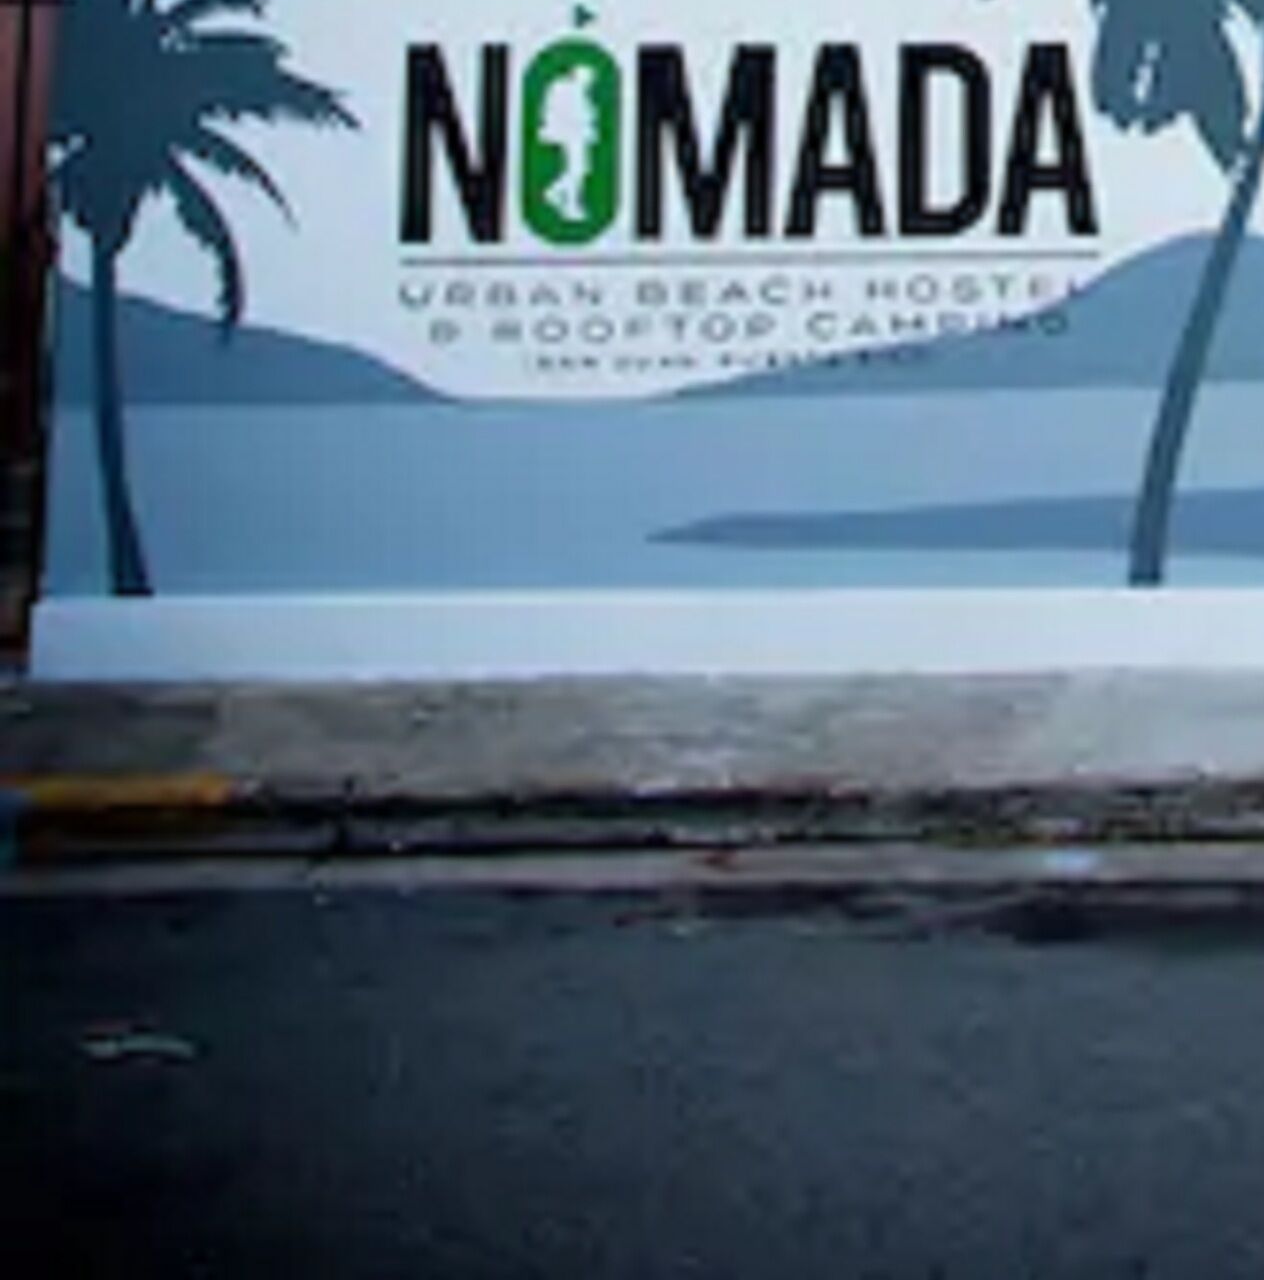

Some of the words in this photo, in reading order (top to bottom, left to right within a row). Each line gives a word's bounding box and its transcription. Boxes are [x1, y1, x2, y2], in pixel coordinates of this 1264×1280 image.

[400, 281, 602, 308] URBAN
[636, 280, 832, 306] BEACH
[491, 314, 777, 343] ROOFTOP
